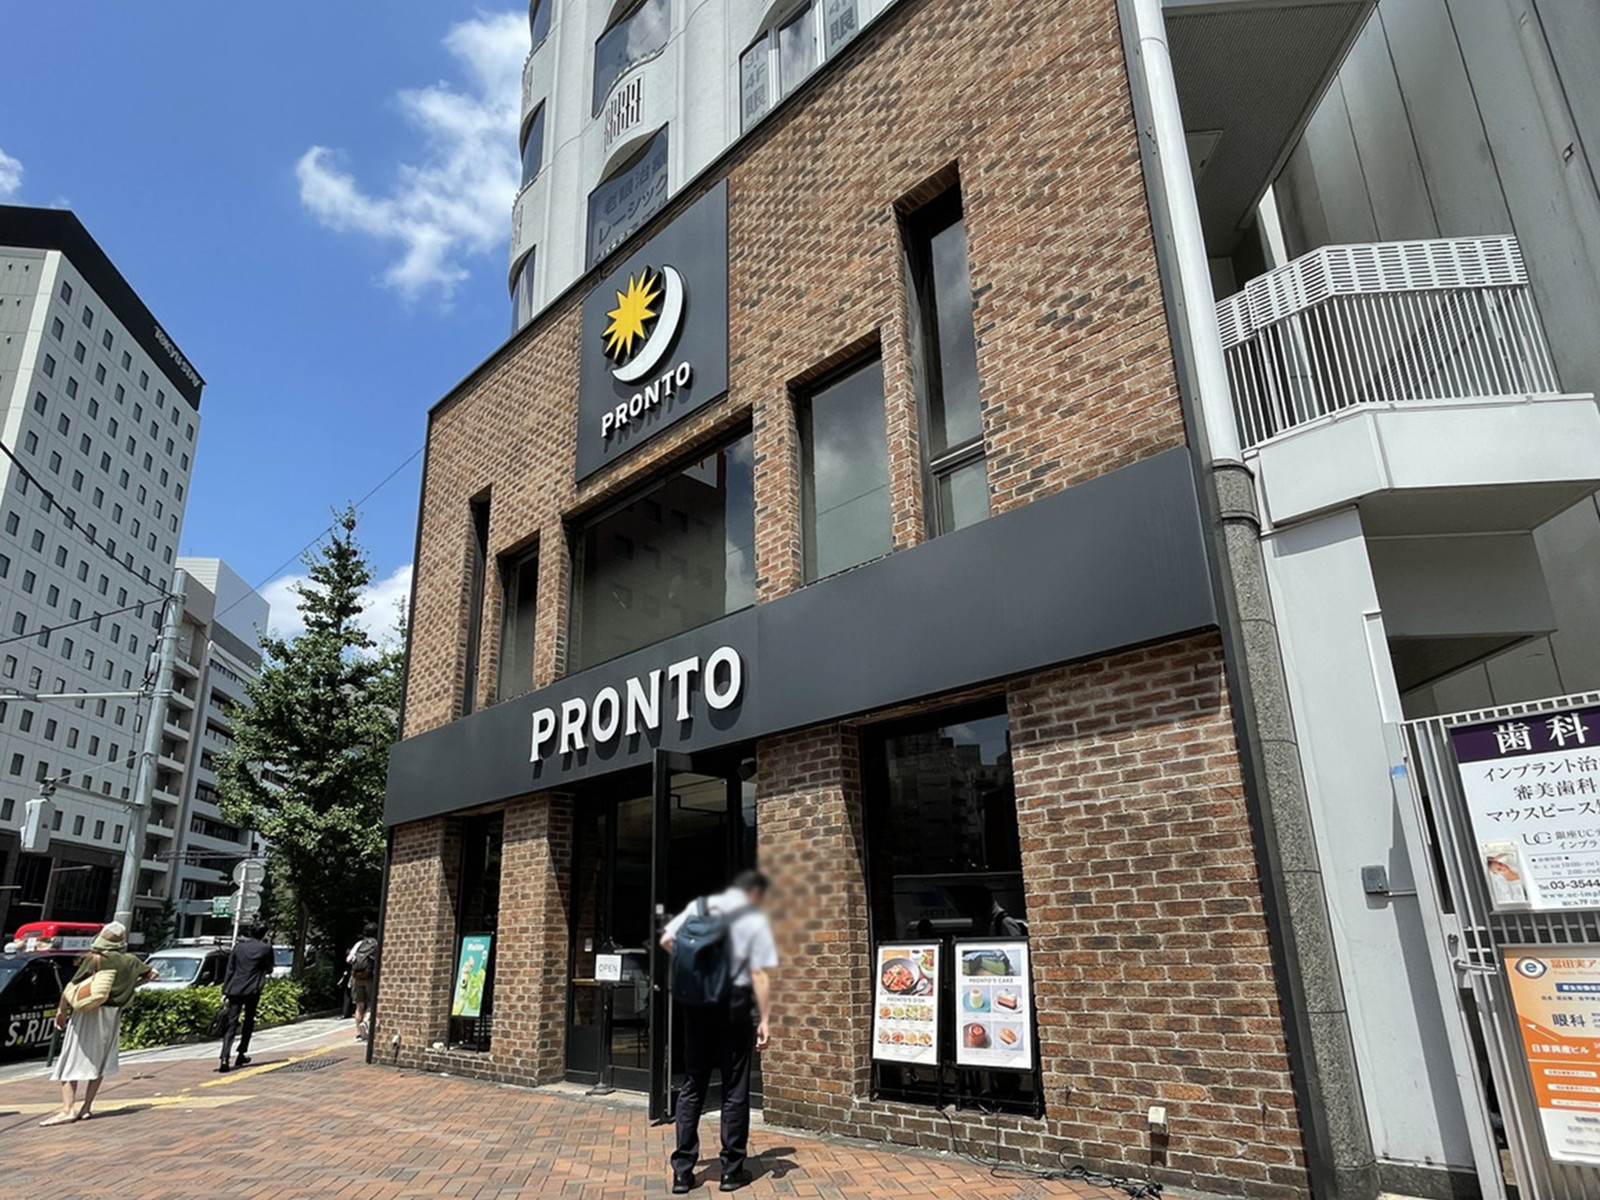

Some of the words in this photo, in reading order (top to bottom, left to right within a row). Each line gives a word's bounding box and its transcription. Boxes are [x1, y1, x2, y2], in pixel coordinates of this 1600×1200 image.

[599, 172, 667, 245] レーシック
[601, 361, 691, 438] PRONTO
[530, 646, 741, 762] PRONTO
[1493, 712, 1589, 754] 歯科
[1483, 755, 1600, 782] インプラント治
[1513, 777, 1597, 800] 審美歯科
[5, 1018, 60, 1047] S.RID
[1552, 1013, 1585, 1028] 眼科
